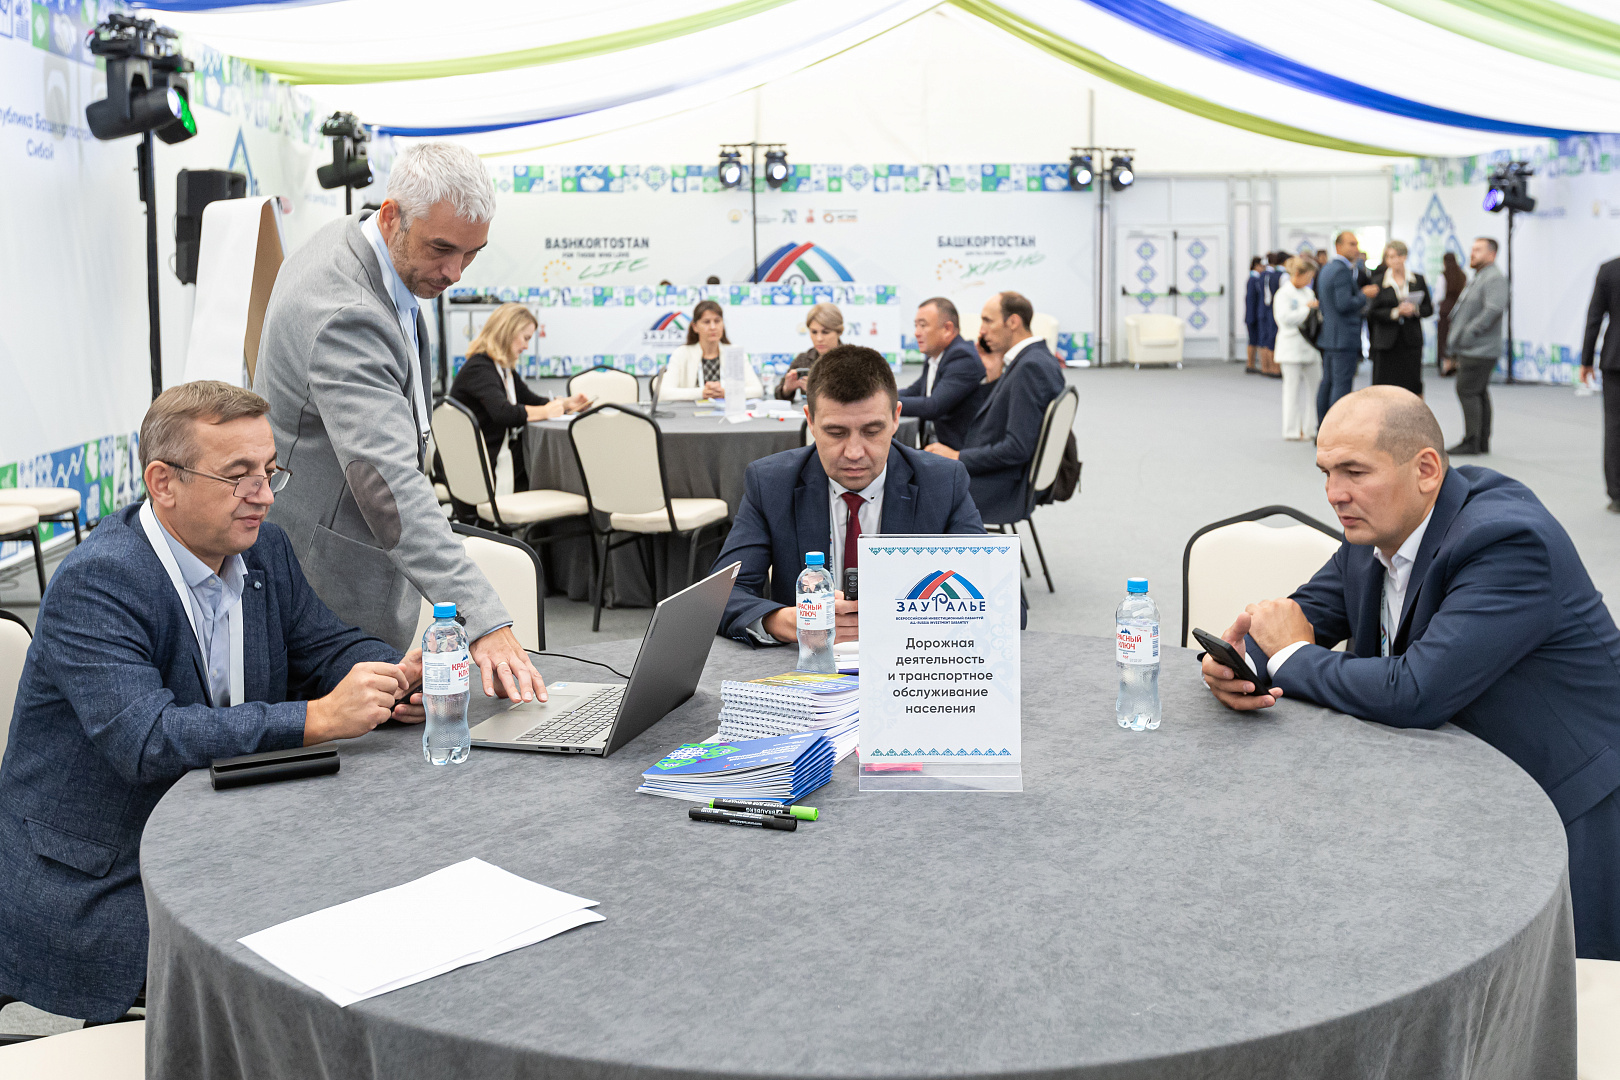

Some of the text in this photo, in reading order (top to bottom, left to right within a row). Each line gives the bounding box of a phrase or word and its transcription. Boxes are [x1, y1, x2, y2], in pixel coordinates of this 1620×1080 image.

[545, 237, 649, 249] BASHKORTOSTAN
[937, 235, 1036, 248] БАШКОРТОСТАН
[578, 257, 649, 280] LIFE
[896, 593, 986, 612] ЗАУРАЛЬЕ
[905, 637, 974, 650] Дорожная
[1116, 633, 1142, 642] РАСНЫЙ
[895, 656, 985, 666] деятельность
[899, 673, 993, 683] транспортное
[892, 687, 988, 699] обслуживание
[905, 705, 976, 713] населения
[745, 807, 776, 815] BRAUBERG
